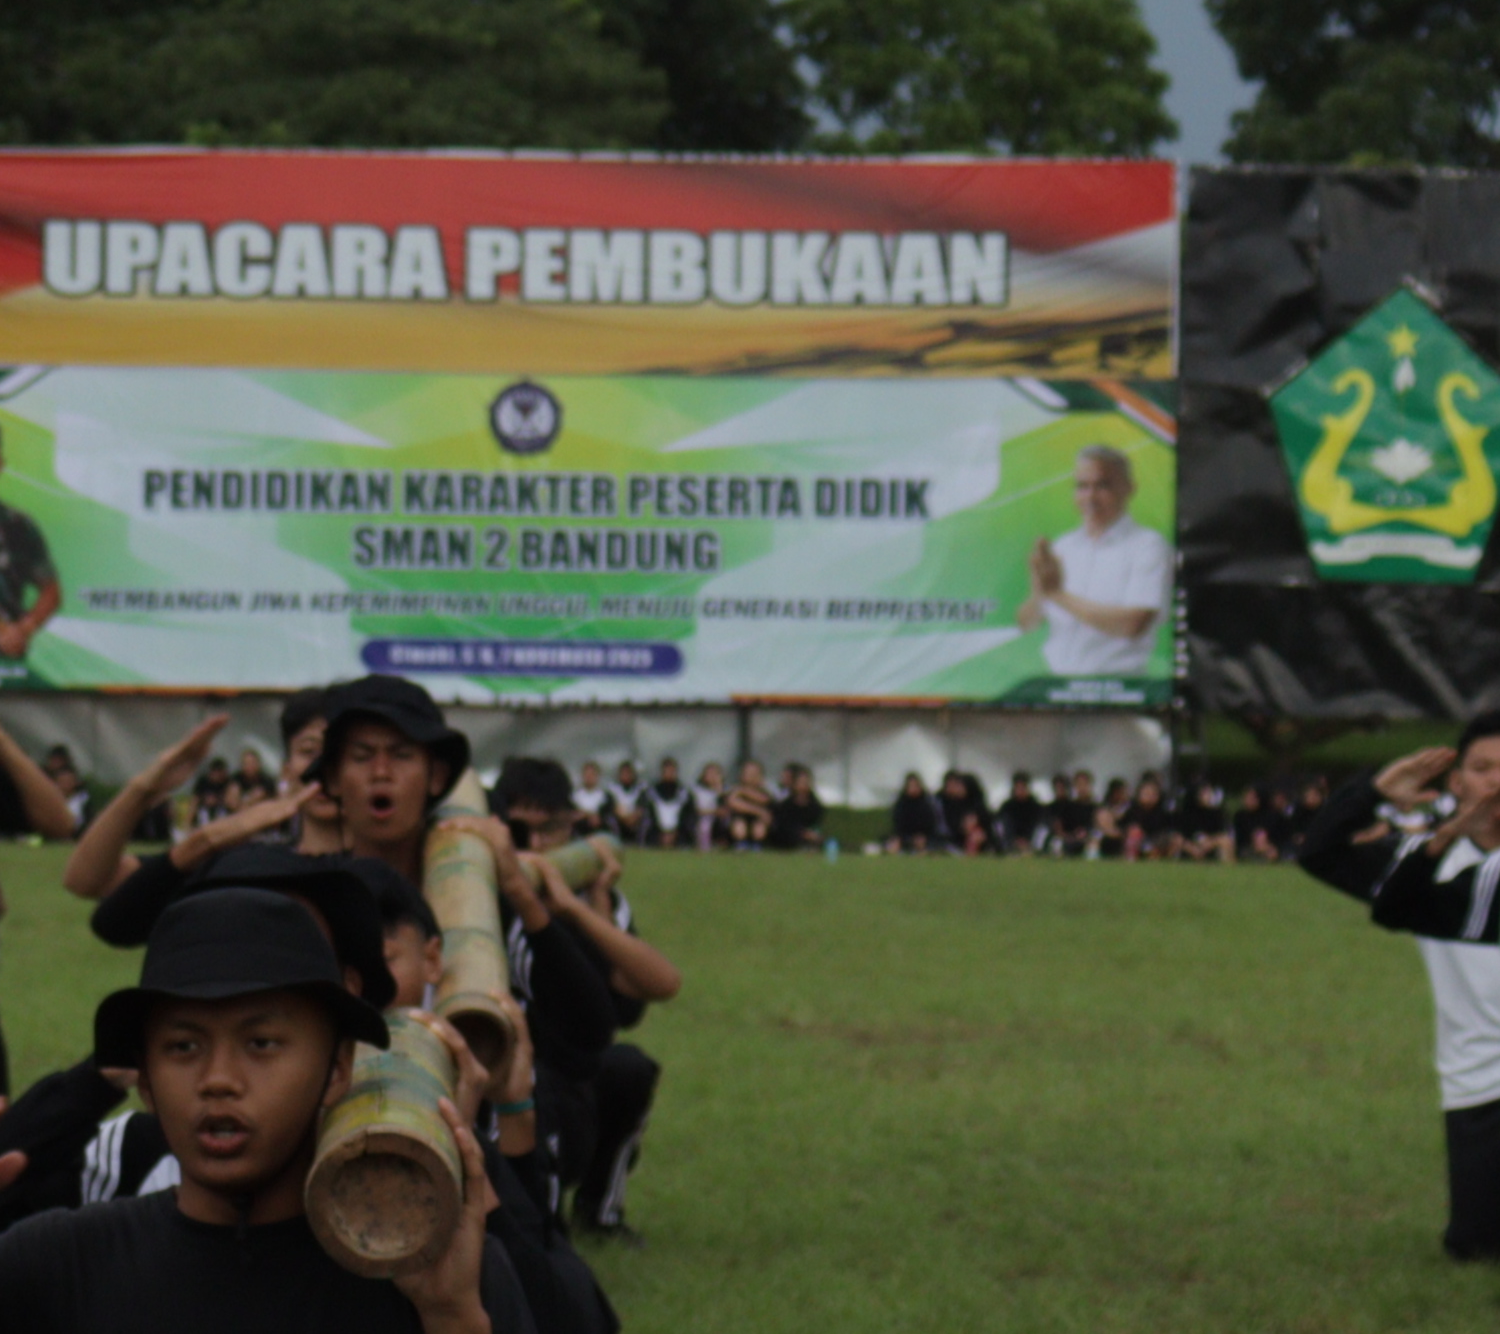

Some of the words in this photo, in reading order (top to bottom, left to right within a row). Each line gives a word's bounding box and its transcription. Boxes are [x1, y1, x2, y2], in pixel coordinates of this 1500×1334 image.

[41, 218, 451, 300] UPACARA
[466, 225, 1008, 307] PEMBUKAAN
[143, 470, 392, 511] PENDIDIKAN
[404, 472, 616, 515] KARAKTER
[627, 475, 802, 517] PESERTA
[813, 477, 931, 519] DIDIK
[353, 526, 472, 567] SMAN
[484, 528, 509, 567] 2
[520, 529, 721, 570] BANDUNG
[248, 591, 301, 613] JIWA
[702, 598, 819, 620] GENERASI
